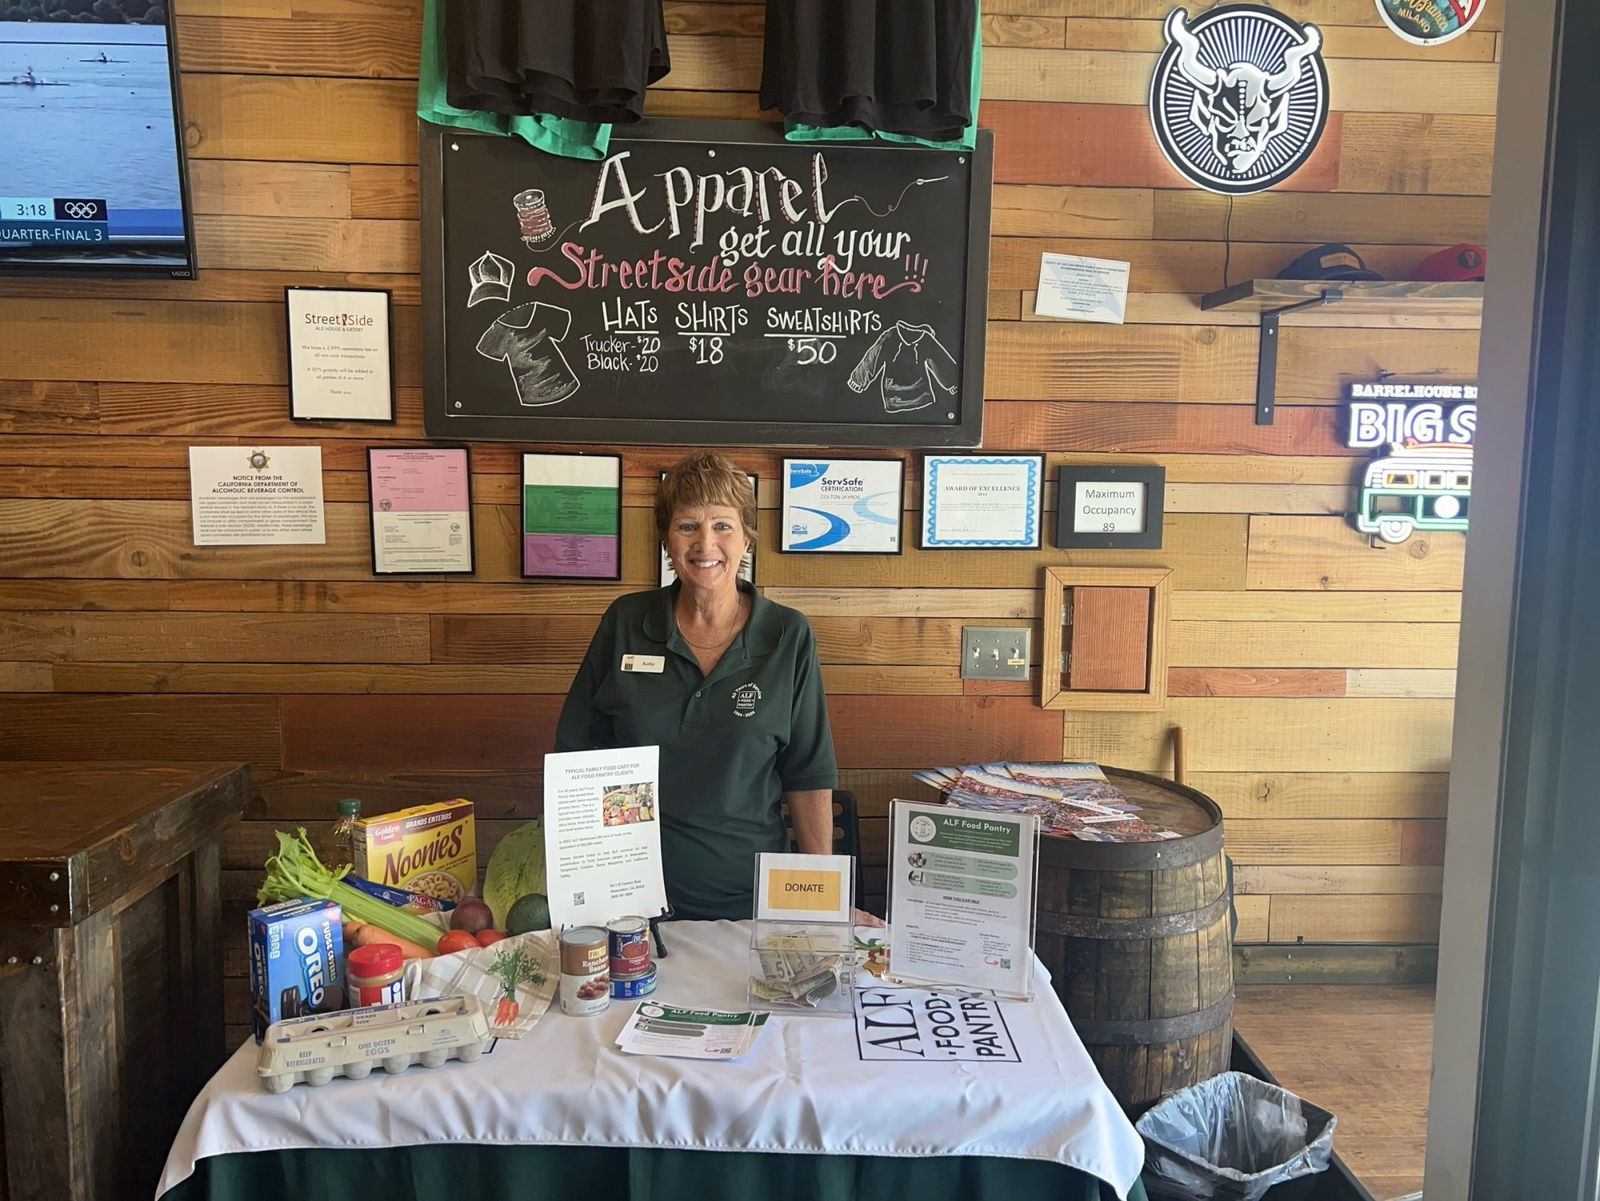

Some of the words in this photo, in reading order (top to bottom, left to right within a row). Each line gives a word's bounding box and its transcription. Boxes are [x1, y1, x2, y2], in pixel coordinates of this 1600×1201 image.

[1397, 8, 1431, 32] MILANO
[16, 203, 47, 216] 3:18
[579, 152, 855, 254] Apparel
[94, 229, 103, 241] 3
[719, 225, 776, 266] get
[781, 221, 825, 257] all
[820, 228, 911, 274] your
[743, 262, 812, 298] gear
[305, 313, 341, 325] Street
[348, 314, 374, 327] Side
[675, 300, 749, 334] SHIRTS
[766, 306, 882, 335] SWEATSHIRTS
[689, 336, 724, 366] $18
[787, 337, 838, 365] $50
[1352, 383, 1462, 399] BARRELHOUSE
[1348, 402, 1444, 448] BIG
[821, 477, 863, 486] ServSafe
[1085, 489, 1135, 499] Maximum
[1082, 505, 1137, 516] Occupancy
[1102, 522, 1115, 532] 89
[961, 820, 981, 830] Food
[983, 823, 1011, 835] Pantry
[383, 825, 463, 886] Noonies
[785, 883, 825, 893] DONATE
[321, 920, 333, 950] FUDGE
[297, 926, 325, 1007] OREO
[860, 989, 925, 1058] ALF
[373, 1038, 396, 1048] DOZEN
[298, 1050, 312, 1059] KEEP
[365, 1047, 390, 1057] EGGS
[286, 1056, 326, 1069] REFRIGERATED
